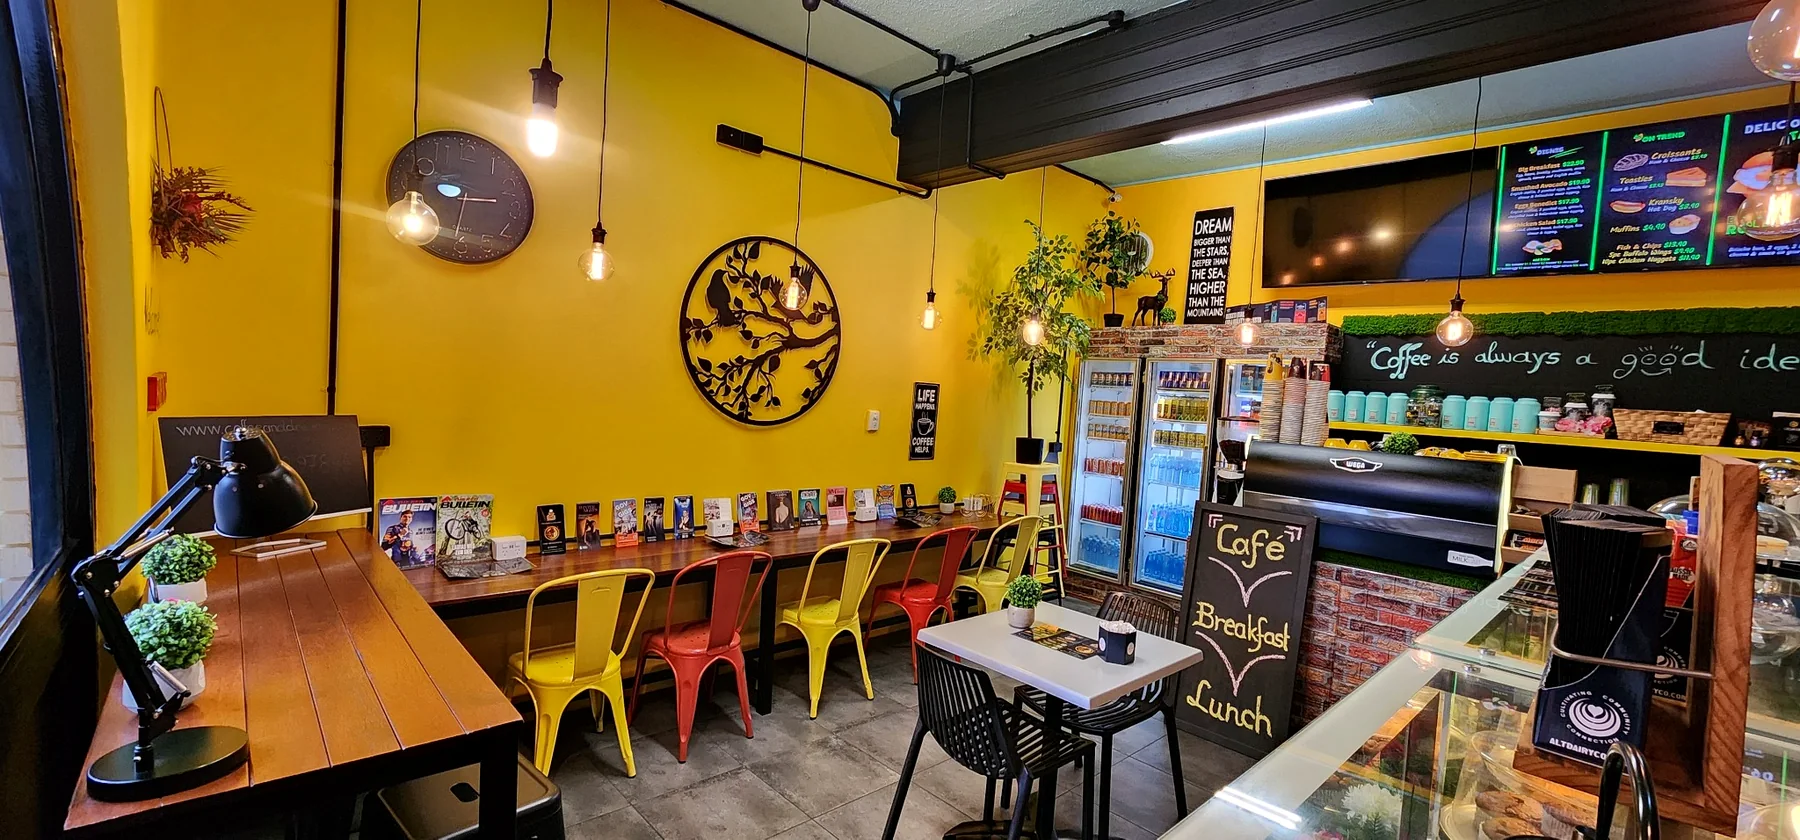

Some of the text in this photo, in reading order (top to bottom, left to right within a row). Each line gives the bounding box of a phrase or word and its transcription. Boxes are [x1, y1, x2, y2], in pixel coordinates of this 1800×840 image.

[1656, 131, 1686, 141] TREND
[1651, 148, 1702, 160] Croissants
[1529, 163, 1561, 171] Breakfast
[1619, 175, 1653, 185] Toasties
[1511, 184, 1540, 192] Smashed
[1540, 181, 1568, 189] Avocado
[1530, 200, 1558, 208] Benedict
[1648, 197, 1684, 206] Kransky
[1662, 205, 1677, 213] Dog
[1194, 216, 1232, 236] DREAM
[1609, 225, 1640, 234] Muffins
[1193, 235, 1231, 247] BIGGER THAN
[1641, 242, 1662, 250] Chips
[1193, 246, 1230, 258] THE STARS,
[1622, 249, 1649, 257] Buffalo
[1650, 249, 1672, 257] Wings
[1191, 257, 1228, 268] DEEPER THAN
[1647, 255, 1677, 263] Nuggets
[1191, 267, 1226, 280] THE SEA,
[1189, 280, 1226, 295] HIGHER
[1188, 295, 1225, 308] THAN THE
[1186, 307, 1224, 318] MOUNTAINS
[1437, 347, 1460, 365] is
[1474, 340, 1562, 375] always
[1575, 353, 1599, 366] a
[1612, 339, 1716, 380] good
[917, 388, 936, 403] LIFE
[912, 437, 934, 447] COFFEE
[1346, 460, 1366, 469] WEGA
[382, 503, 436, 515] BULLETIN
[440, 501, 490, 509] BULLETIN
[1216, 523, 1286, 569] Café
[1192, 601, 1291, 653] Breakfast
[1186, 679, 1273, 738] Lunch
[1560, 690, 1593, 718] CULTIVATING
[1602, 694, 1631, 736] COMMUNITY
[1566, 724, 1620, 744] CONNECTION
